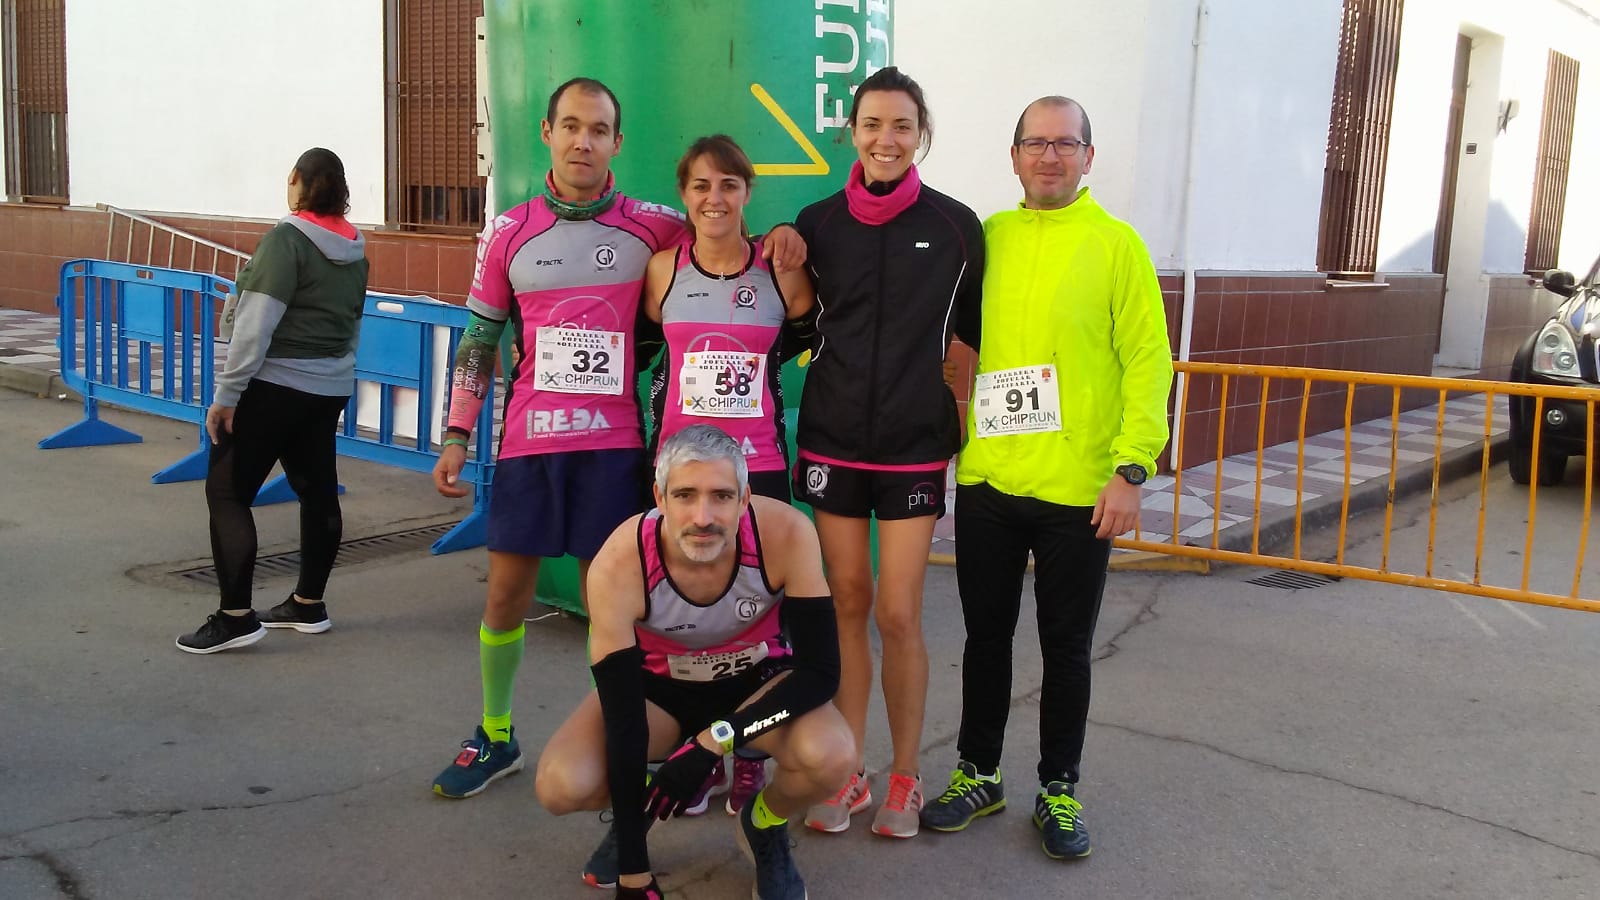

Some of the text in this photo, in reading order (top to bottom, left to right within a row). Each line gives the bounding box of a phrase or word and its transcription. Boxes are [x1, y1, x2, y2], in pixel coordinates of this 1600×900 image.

[815, 0, 860, 133] FU
[572, 350, 610, 374] 32
[564, 373, 619, 386] CHIPRUN
[714, 372, 751, 397] 58
[1005, 387, 1040, 413] 91
[1001, 411, 1056, 426] CHIPRUN
[711, 656, 753, 680] 25
